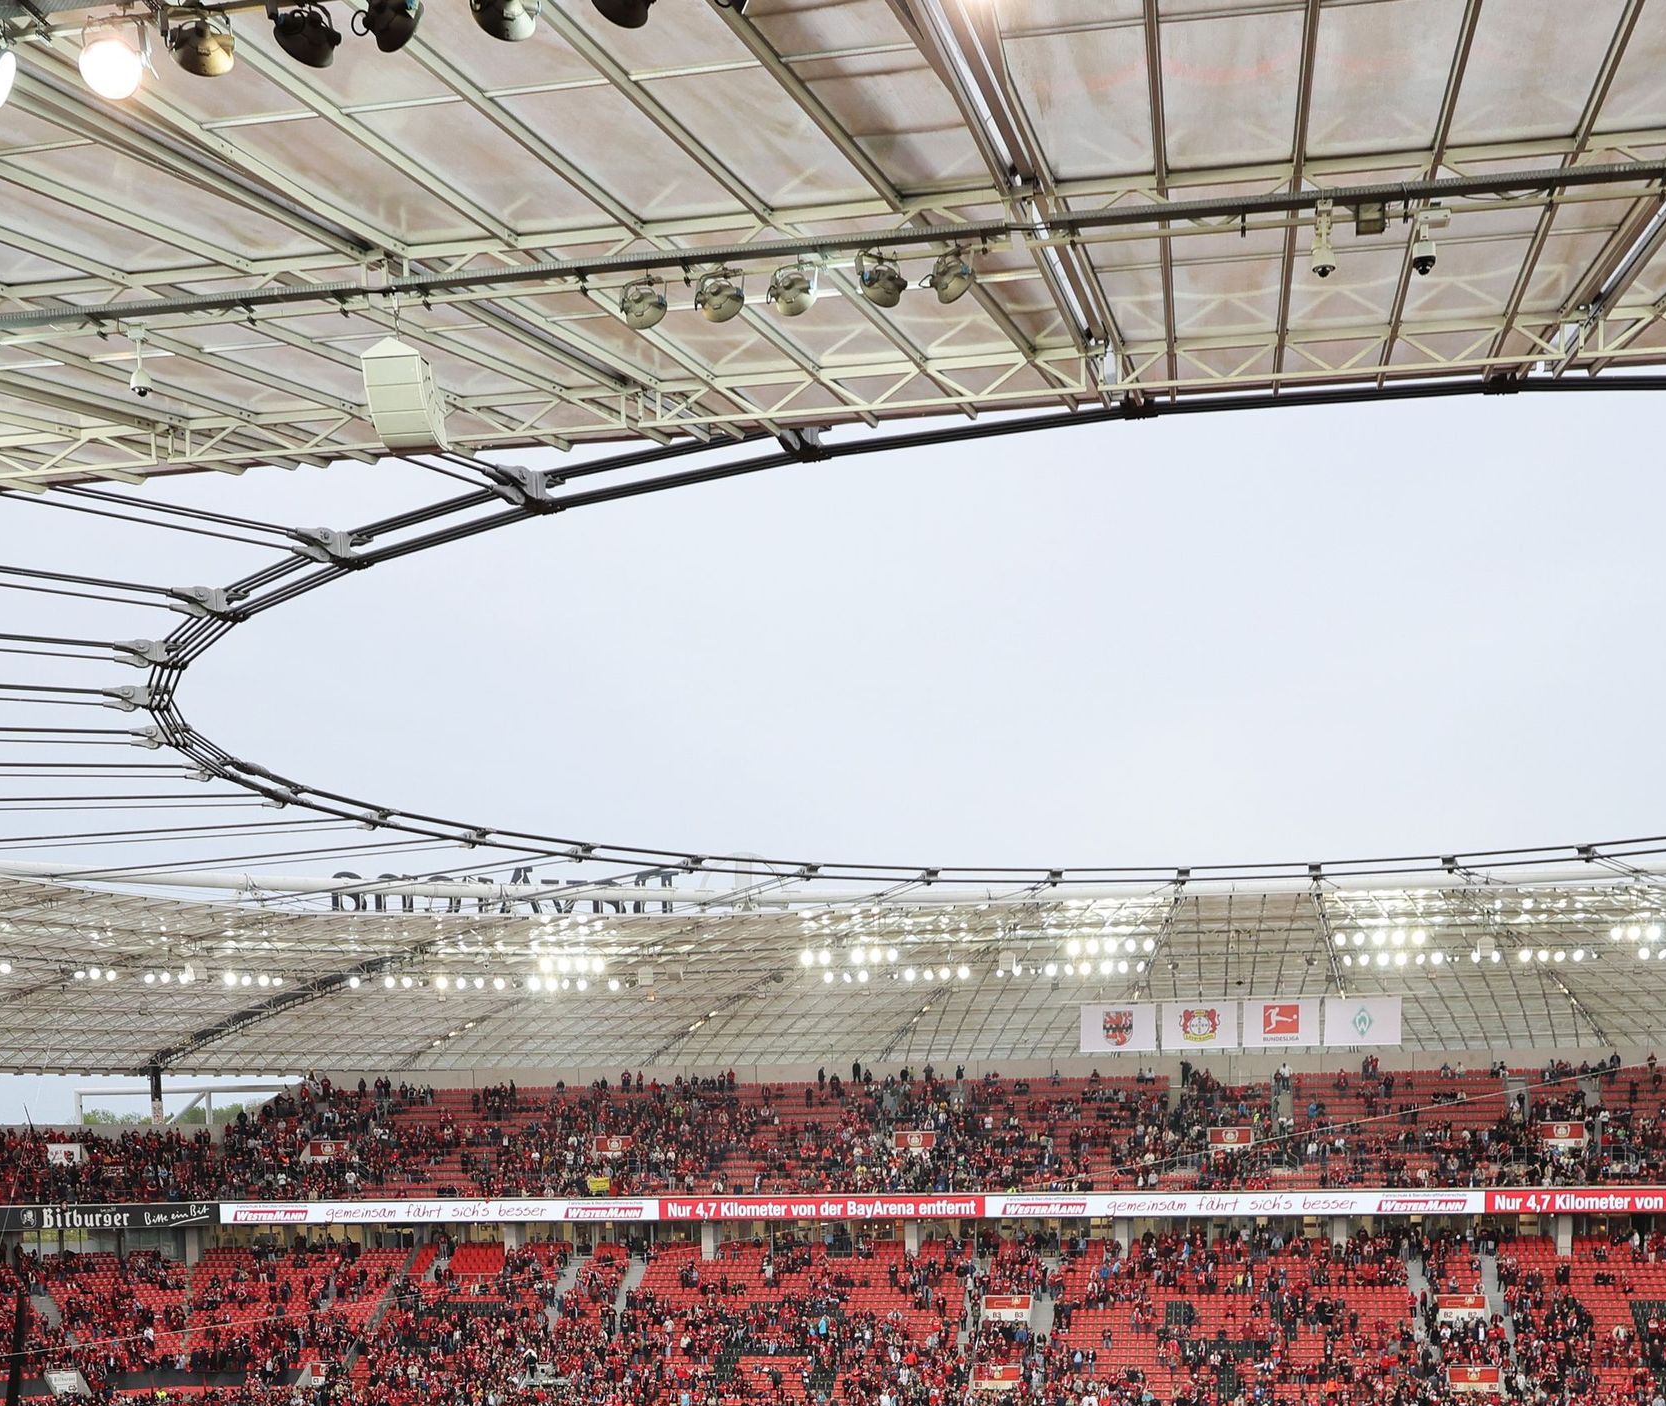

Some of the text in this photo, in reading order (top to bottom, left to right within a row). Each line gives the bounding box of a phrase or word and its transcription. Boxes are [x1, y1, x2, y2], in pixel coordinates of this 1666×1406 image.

[326, 1202, 547, 1222] gemeinsam fährt sich's besser
[667, 1200, 976, 1219] Nur 4,7 Kilometer von der BayArena entfernt
[1005, 1203, 1084, 1215] WESTERMANN
[1107, 1196, 1357, 1216] gemeinsam fährt sich's besser
[1381, 1199, 1465, 1212] WESTERMANN
[1495, 1195, 1521, 1210] Nur
[1526, 1195, 1550, 1212] 4,7
[1555, 1194, 1630, 1210] Kilometer
[1634, 1197, 1664, 1209] von
[42, 1205, 130, 1228] Bitburger
[144, 1204, 209, 1226] Bitte ein Bit
[236, 1210, 307, 1221] WESTERMANN
[568, 1207, 641, 1219] WESTERMANN
